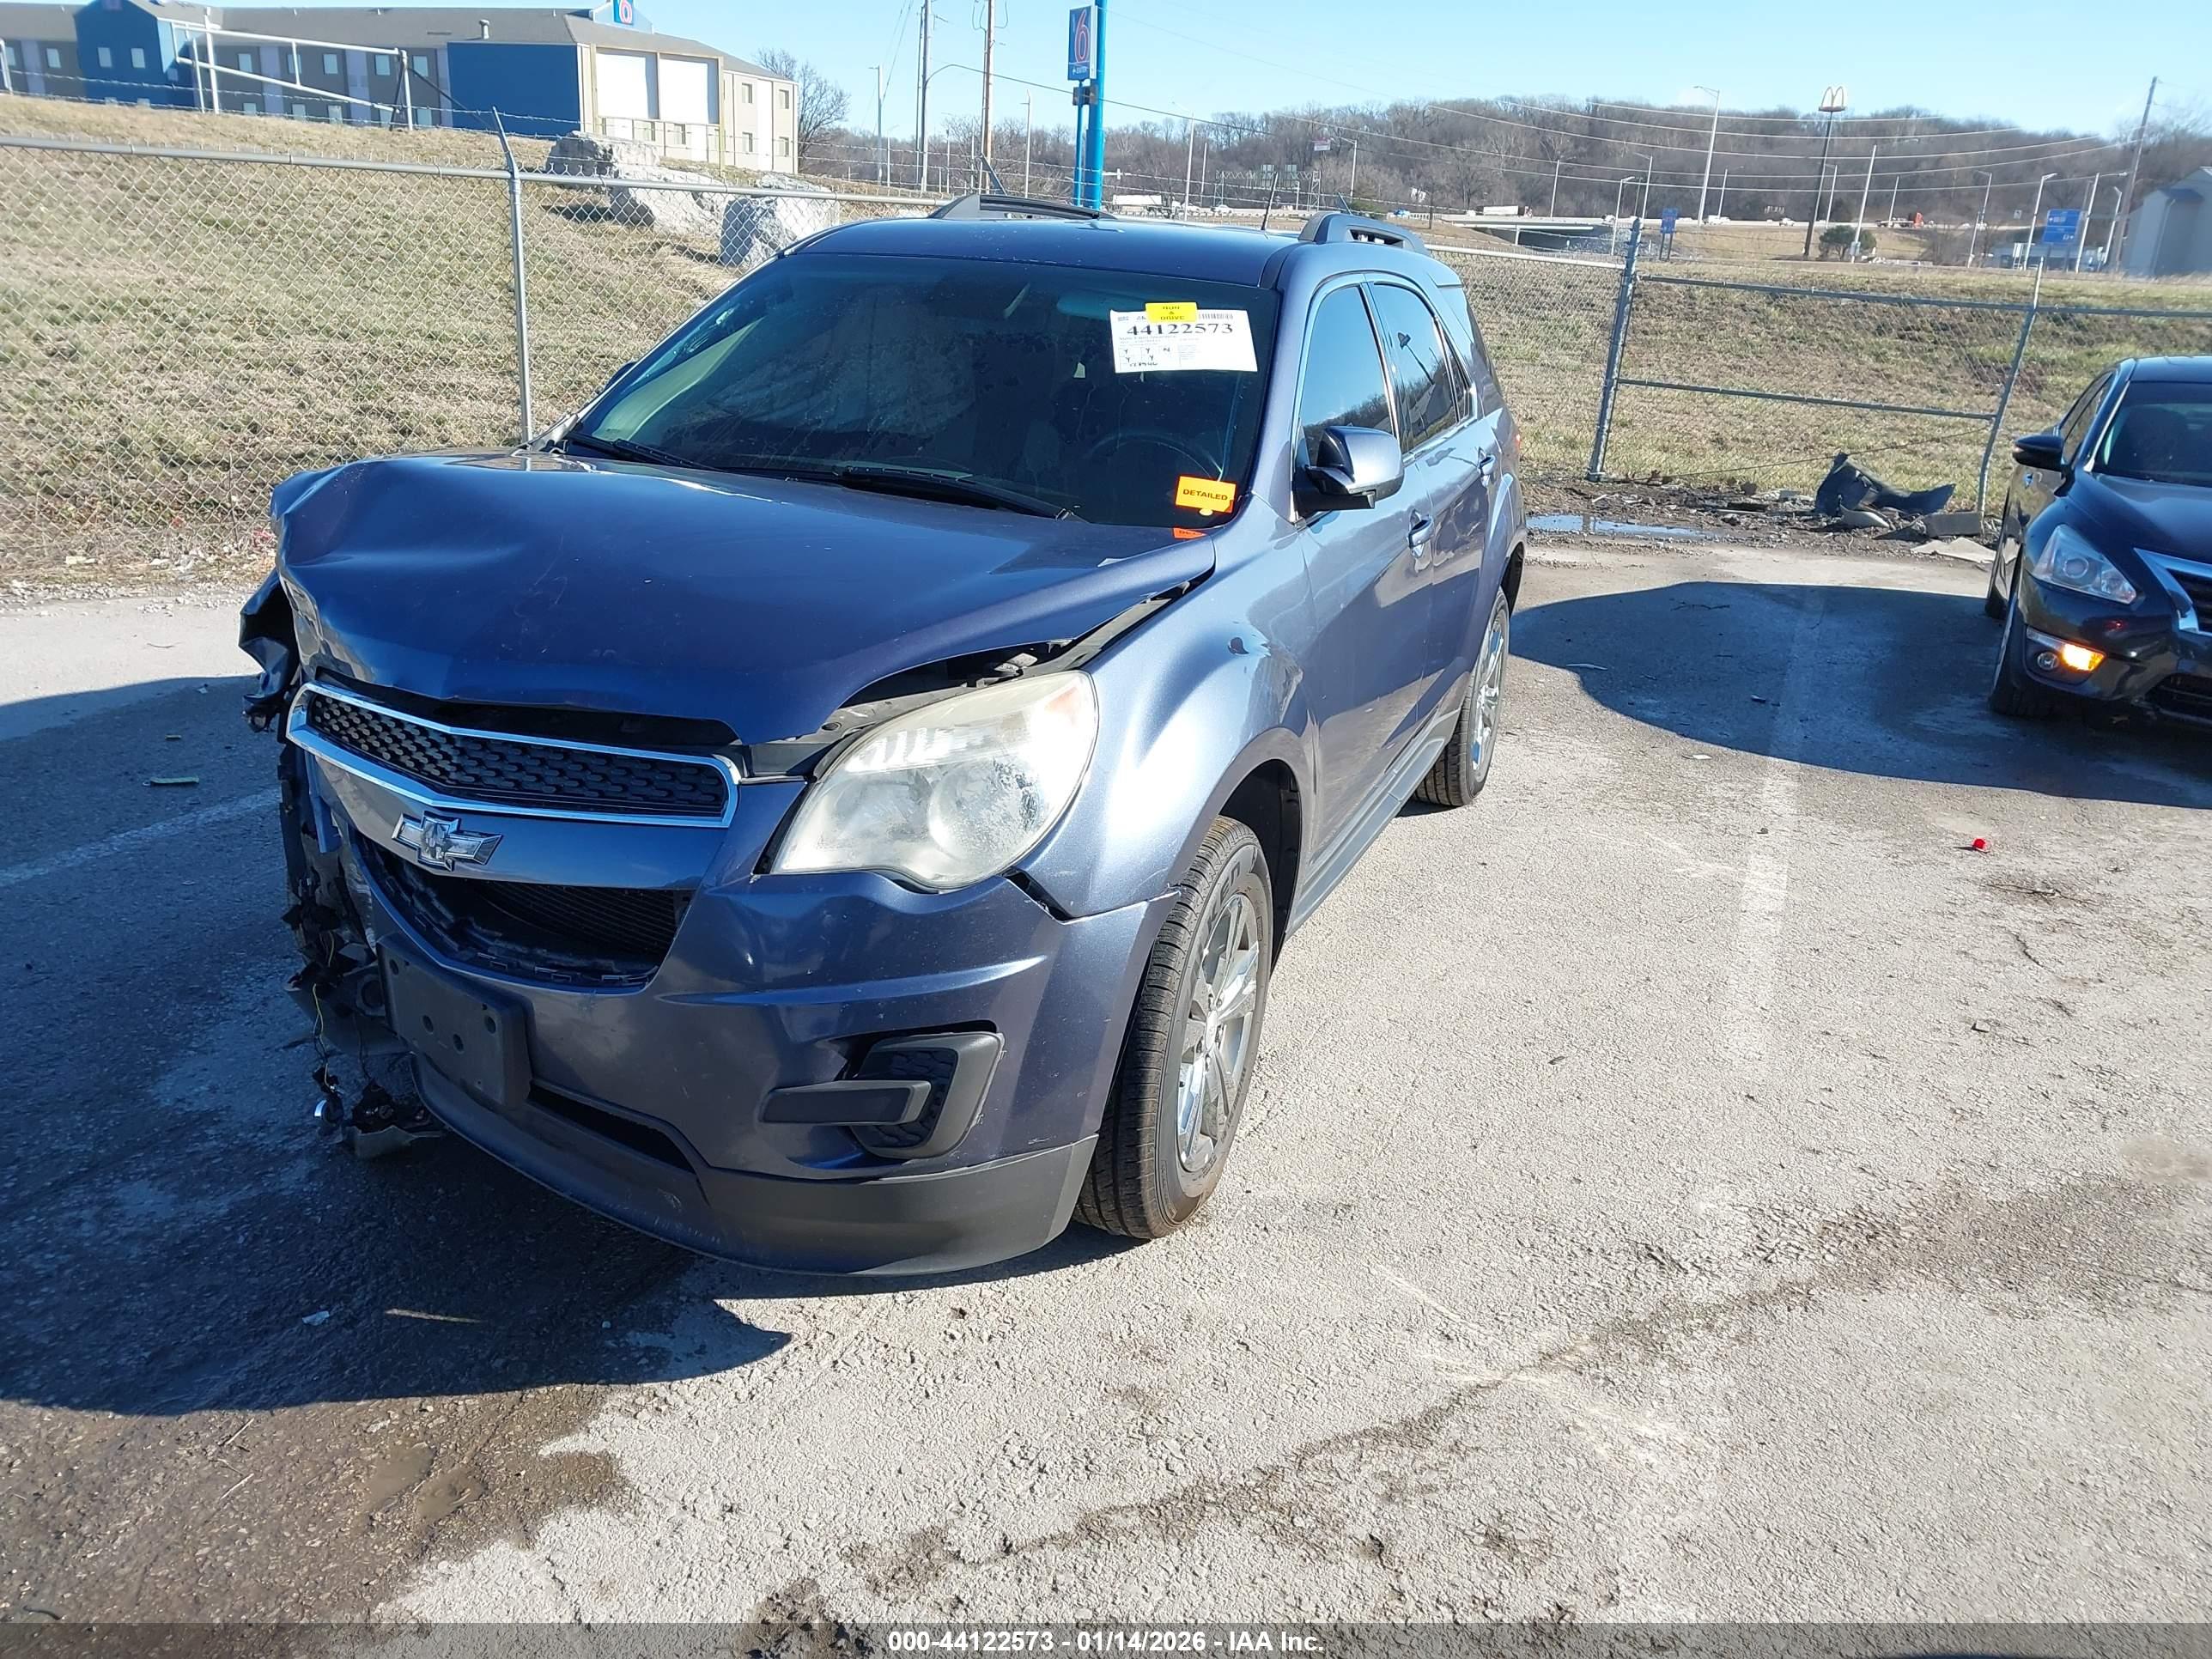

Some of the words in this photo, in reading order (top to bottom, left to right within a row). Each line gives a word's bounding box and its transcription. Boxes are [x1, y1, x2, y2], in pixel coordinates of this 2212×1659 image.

[1075, 9, 1091, 63] 6
[1127, 324, 1233, 335] 44122573
[1183, 489, 1228, 501] DETAILED
